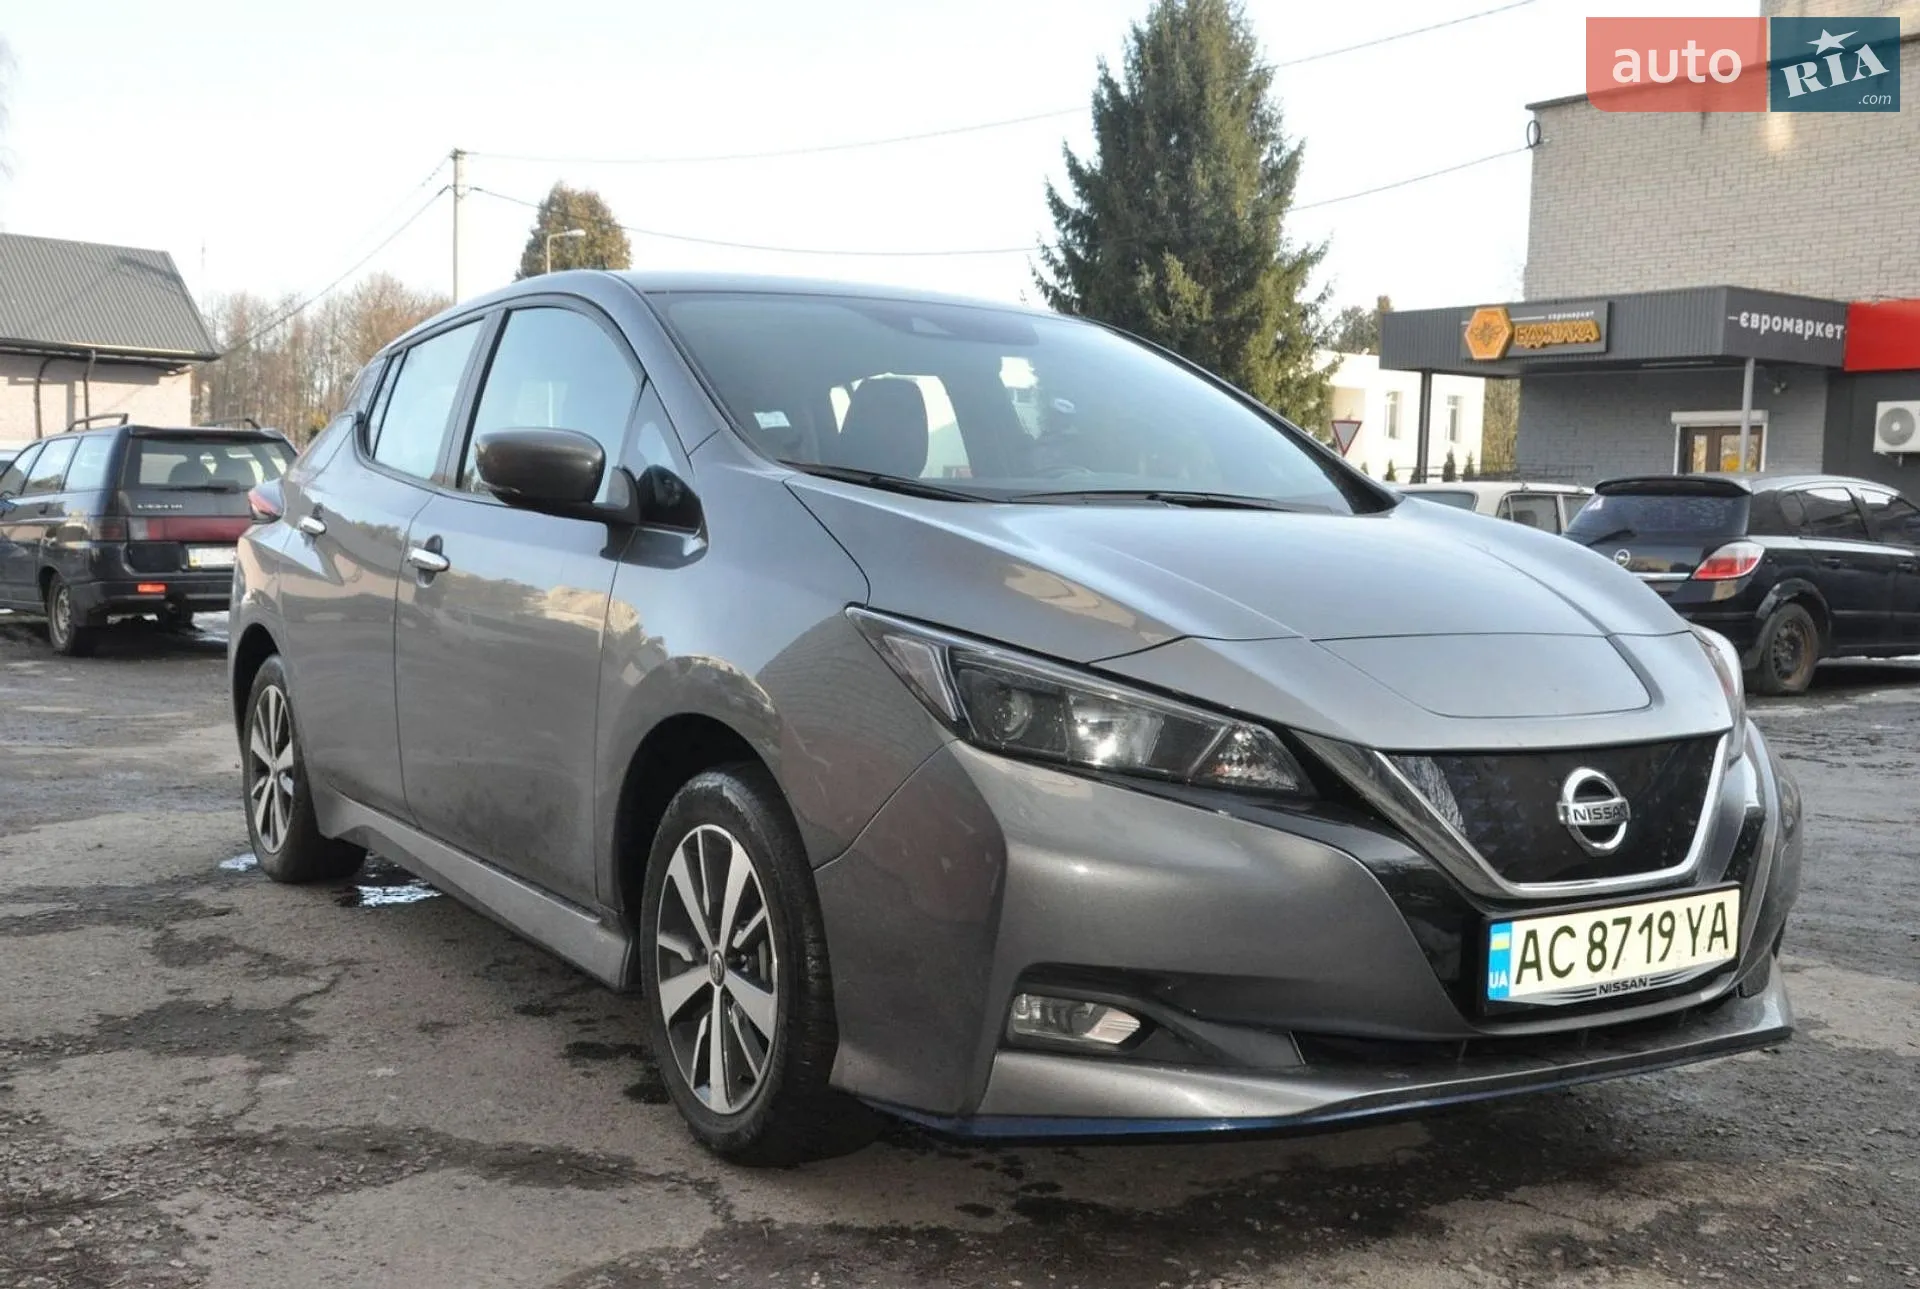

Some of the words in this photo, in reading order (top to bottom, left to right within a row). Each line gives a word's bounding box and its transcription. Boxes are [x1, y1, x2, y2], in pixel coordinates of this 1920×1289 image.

[1515, 925, 1577, 985] AC
[1586, 910, 1676, 973] 8719
[1686, 901, 1729, 958] YA
[1489, 971, 1508, 988] UA
[1598, 977, 1648, 994] NISSAN
